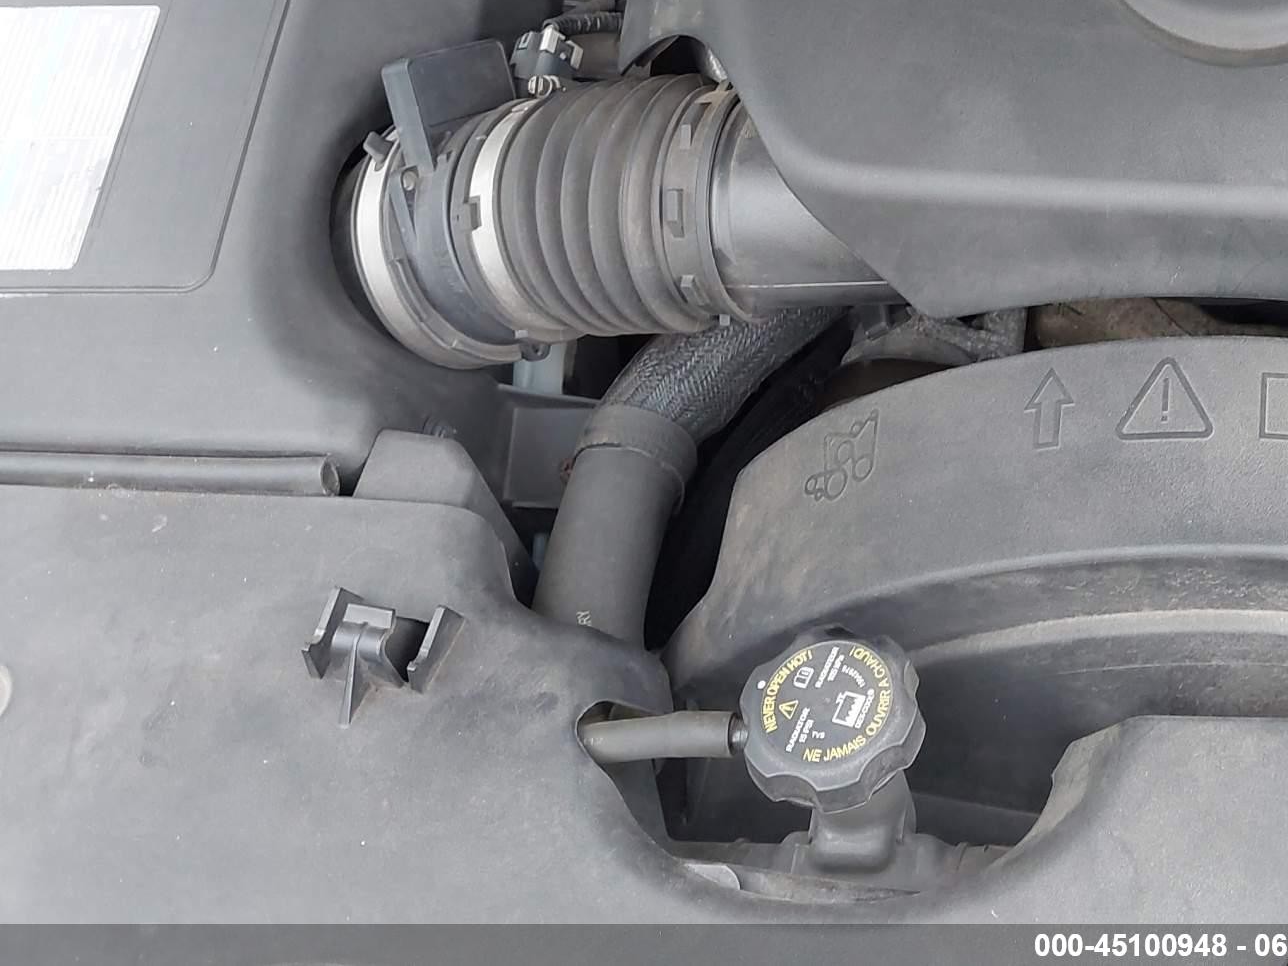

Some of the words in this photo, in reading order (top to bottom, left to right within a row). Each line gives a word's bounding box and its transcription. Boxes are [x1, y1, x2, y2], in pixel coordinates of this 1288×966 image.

[849, 646, 886, 678] CHAUD!
[766, 666, 790, 696] OPEN
[878, 677, 890, 688] A
[762, 695, 778, 733] NEVER
[865, 689, 891, 736] OUVRIR
[803, 748, 822, 762] NE
[824, 735, 866, 762] JAMAIS
